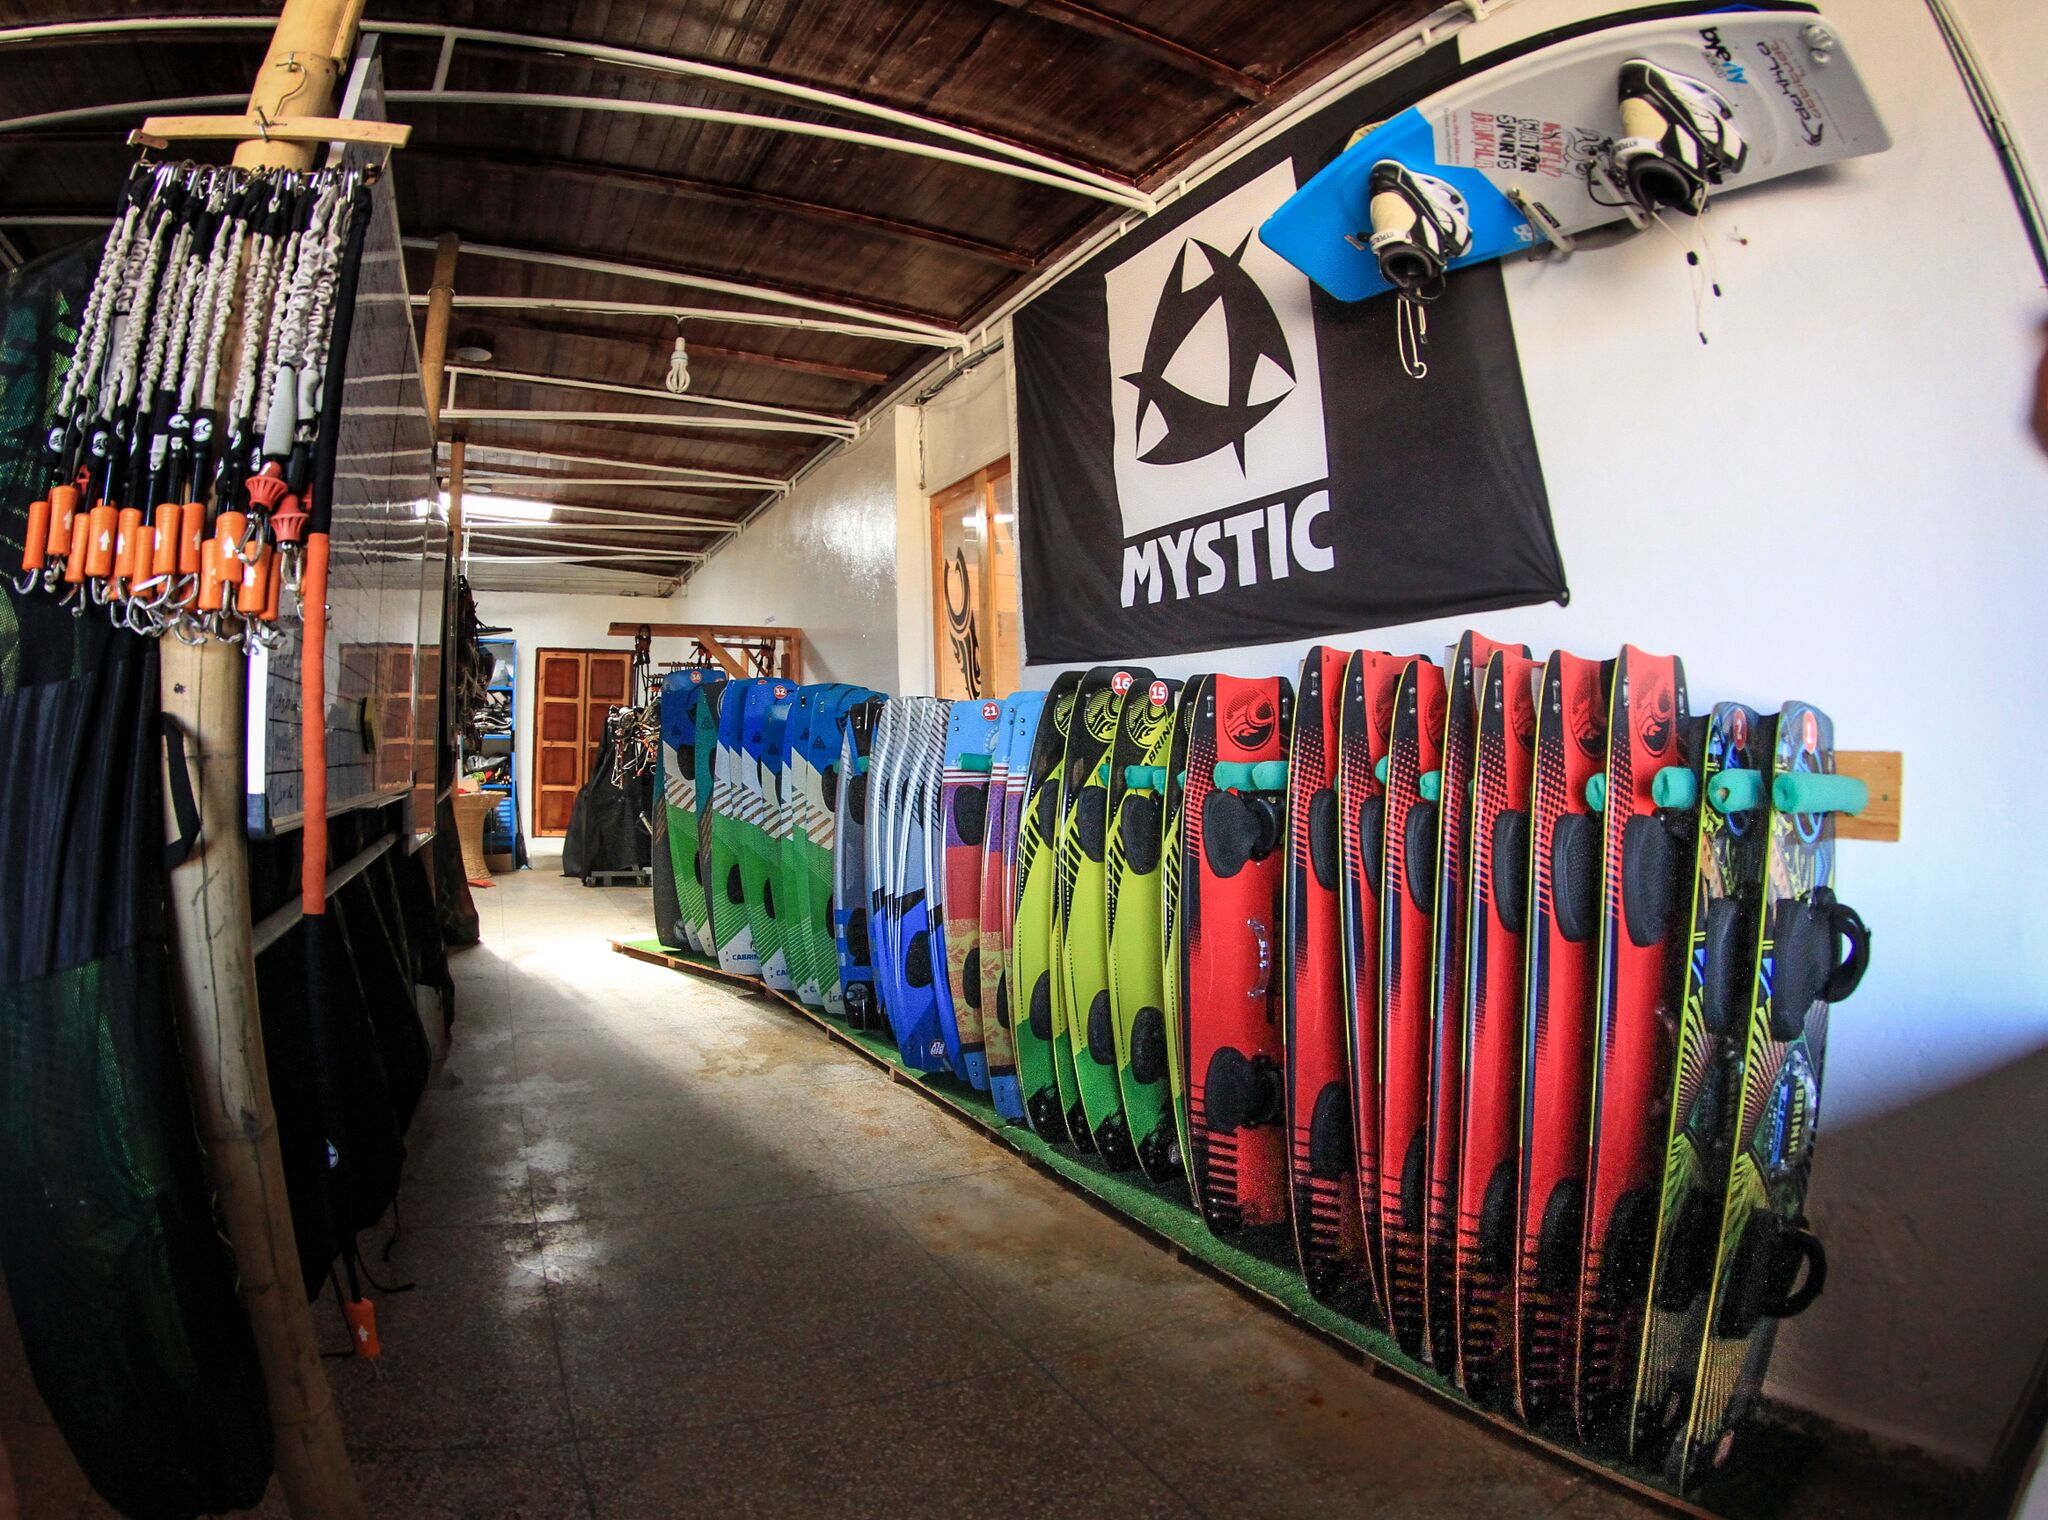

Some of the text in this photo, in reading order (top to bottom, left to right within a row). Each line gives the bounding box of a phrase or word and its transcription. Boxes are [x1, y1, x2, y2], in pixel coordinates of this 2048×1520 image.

[1700, 27, 1749, 85] byerly
[1495, 114, 1517, 171] SPORTS
[1120, 489, 1335, 609] MYSTIC
[775, 687, 786, 696] 32
[1115, 677, 1130, 690] 16
[1151, 686, 1166, 700] 15
[983, 705, 998, 717] 21
[1736, 719, 1742, 740] 2
